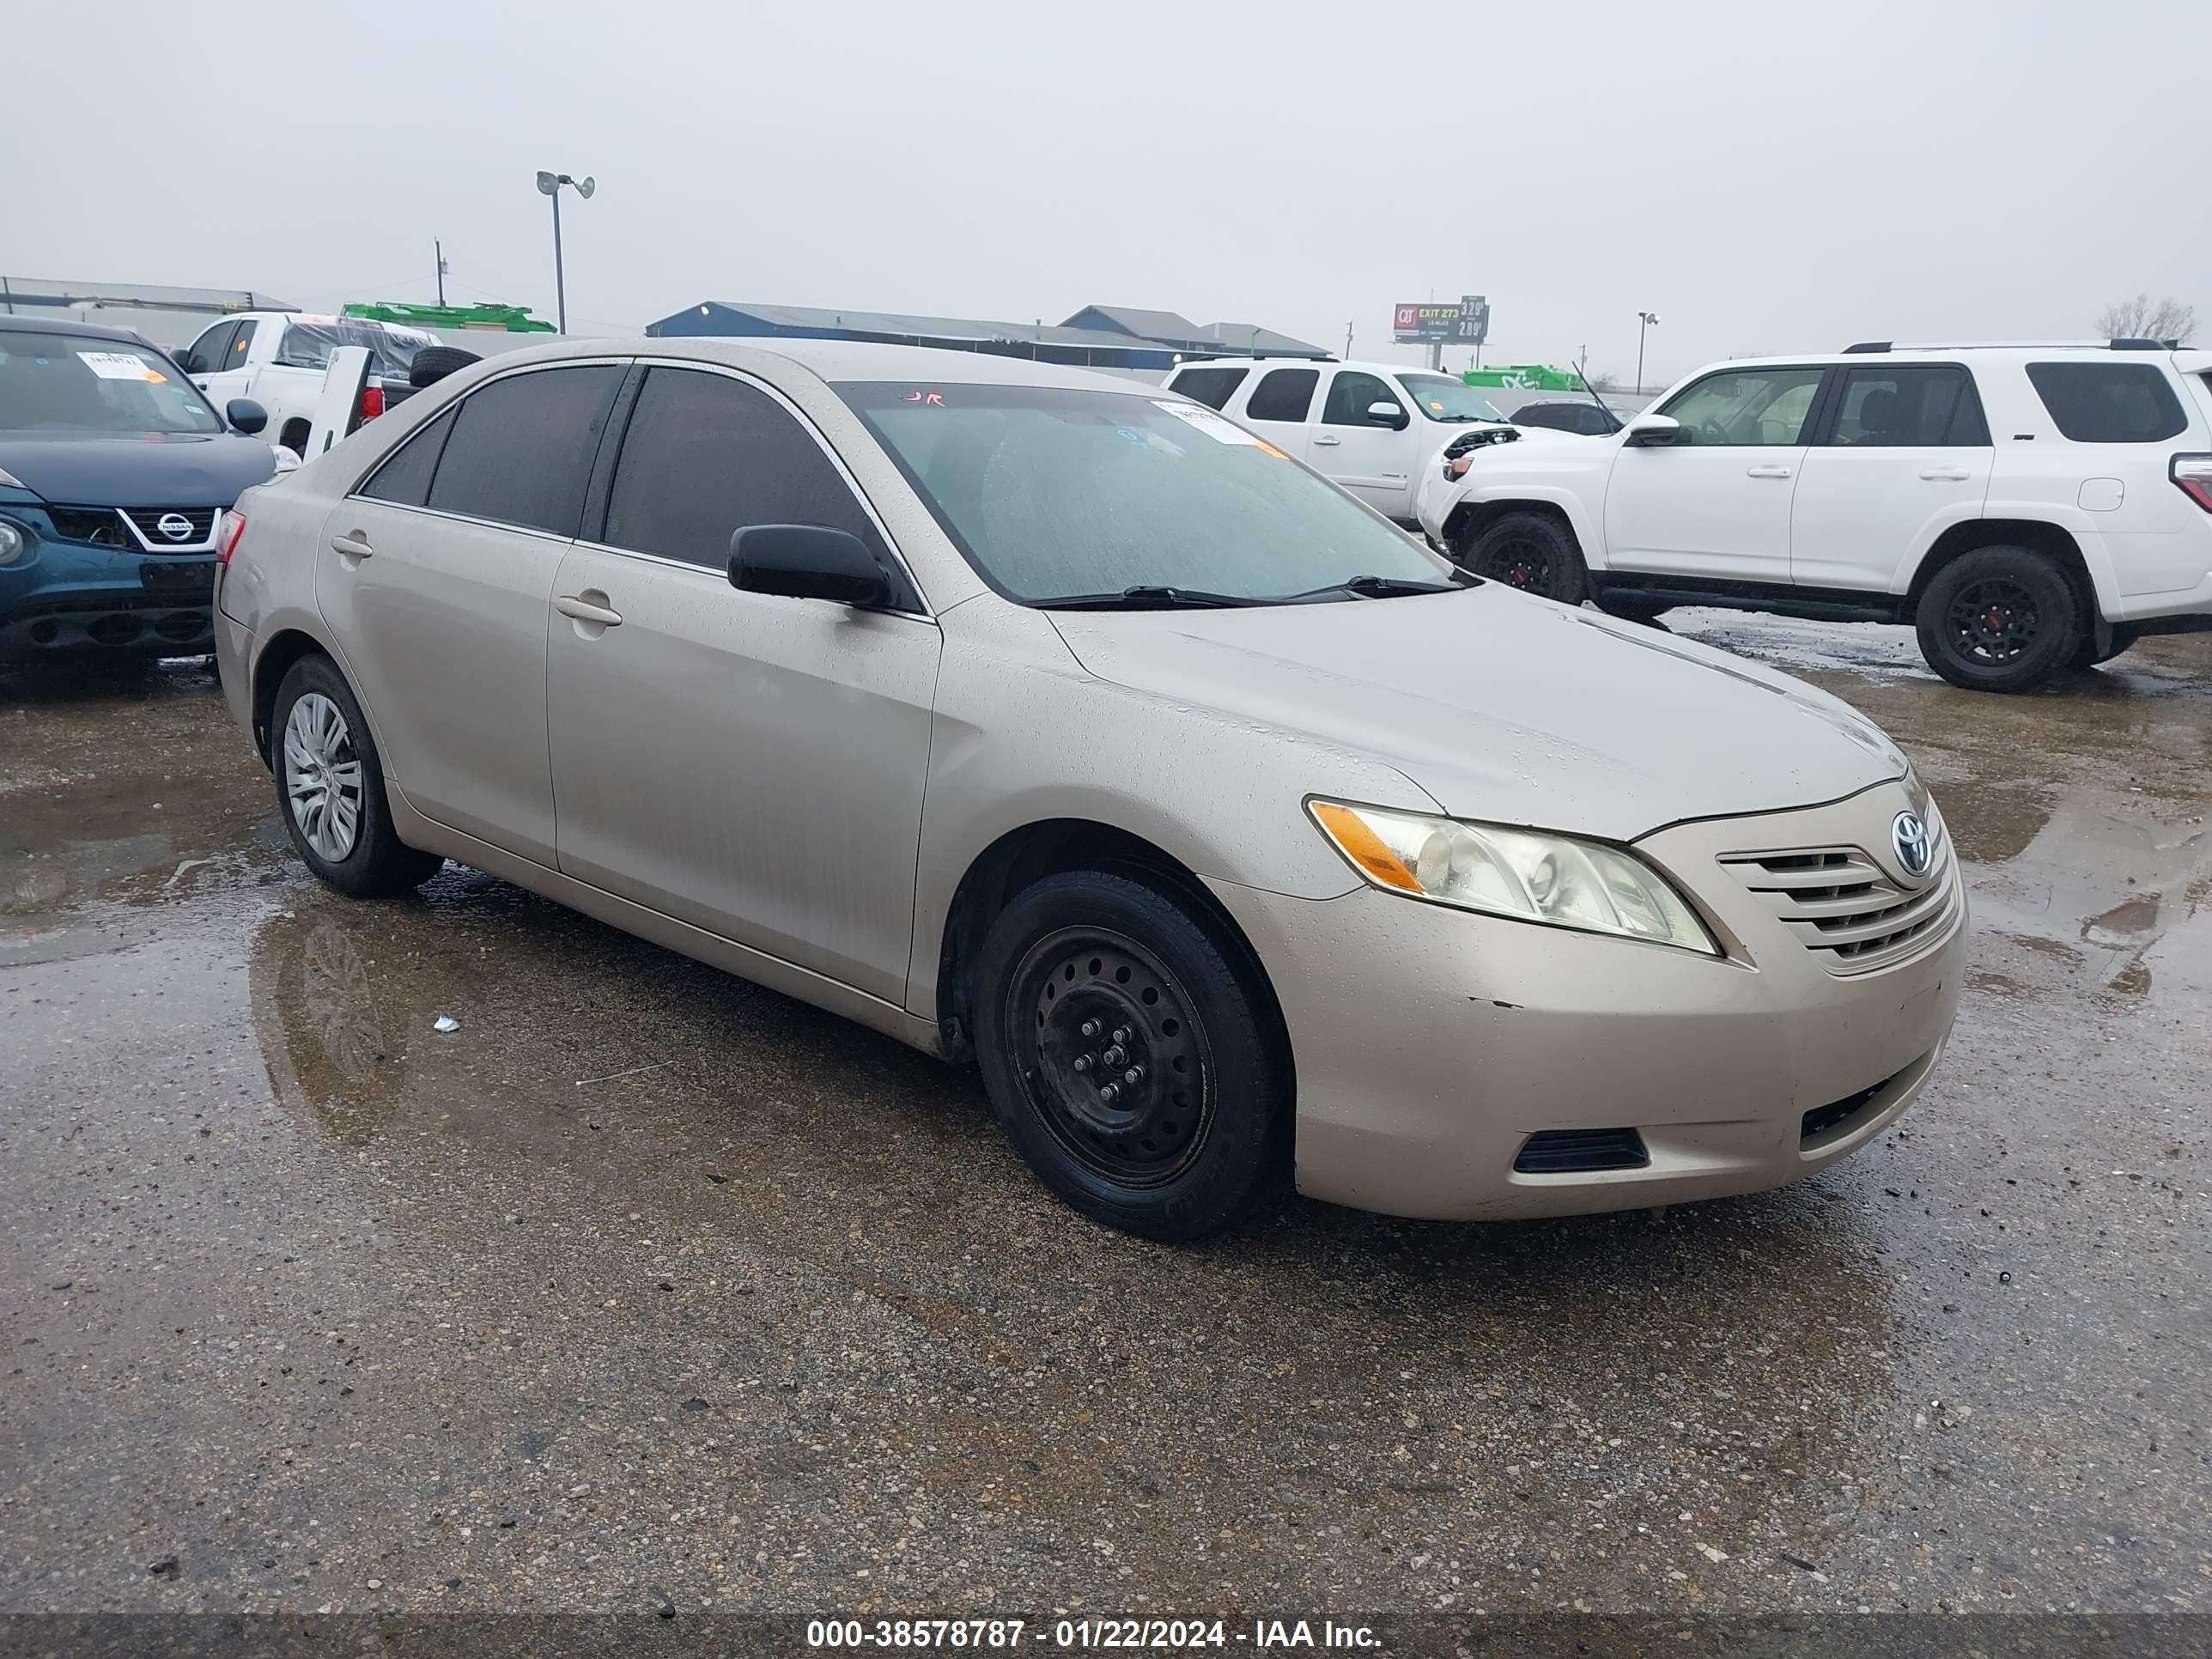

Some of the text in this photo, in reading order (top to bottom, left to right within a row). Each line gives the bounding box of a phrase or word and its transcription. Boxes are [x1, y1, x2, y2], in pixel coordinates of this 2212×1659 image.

[1398, 309, 1415, 324] QT
[1419, 309, 1459, 319] EXIT 273
